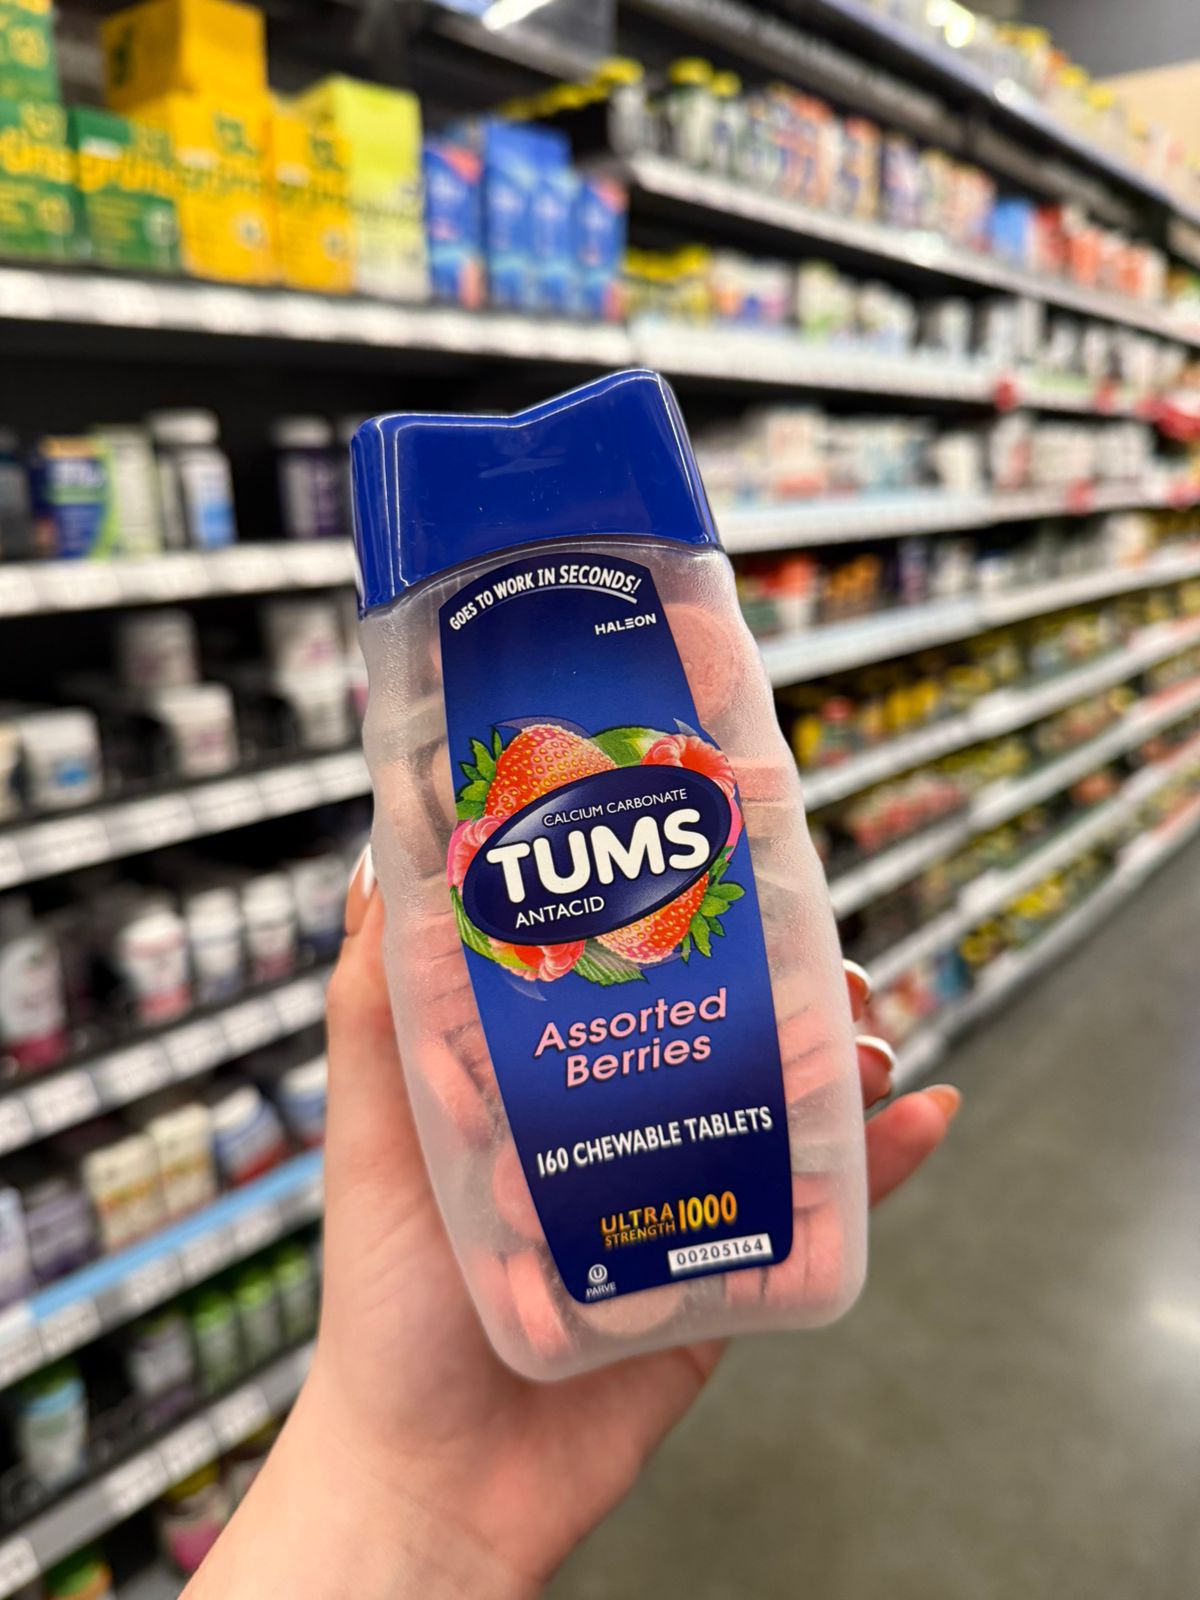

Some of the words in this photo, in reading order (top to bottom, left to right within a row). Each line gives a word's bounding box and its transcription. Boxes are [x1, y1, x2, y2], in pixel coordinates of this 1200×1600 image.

[449, 602, 478, 631] GOES
[475, 590, 494, 610] TO
[492, 572, 535, 600] WORK
[538, 568, 556, 586] IN
[559, 565, 642, 594] SECONDS!
[594, 613, 657, 636] HALEON
[543, 804, 604, 827] CALCIUM
[606, 788, 688, 814] CARBONATE
[486, 808, 710, 903] TUMS
[515, 895, 605, 929] ANTACID
[534, 987, 728, 1057] Assorted
[566, 1035, 712, 1088] Berries
[537, 1147, 569, 1177] 160
[573, 1121, 681, 1166] CHEWABLE
[684, 1106, 773, 1142] TABLETS
[601, 1202, 674, 1233] ULTRA
[678, 1191, 737, 1231] 1000
[605, 1221, 675, 1247] STRENGTH
[676, 1238, 764, 1265] 00205164
[586, 1282, 616, 1297] PARVE
